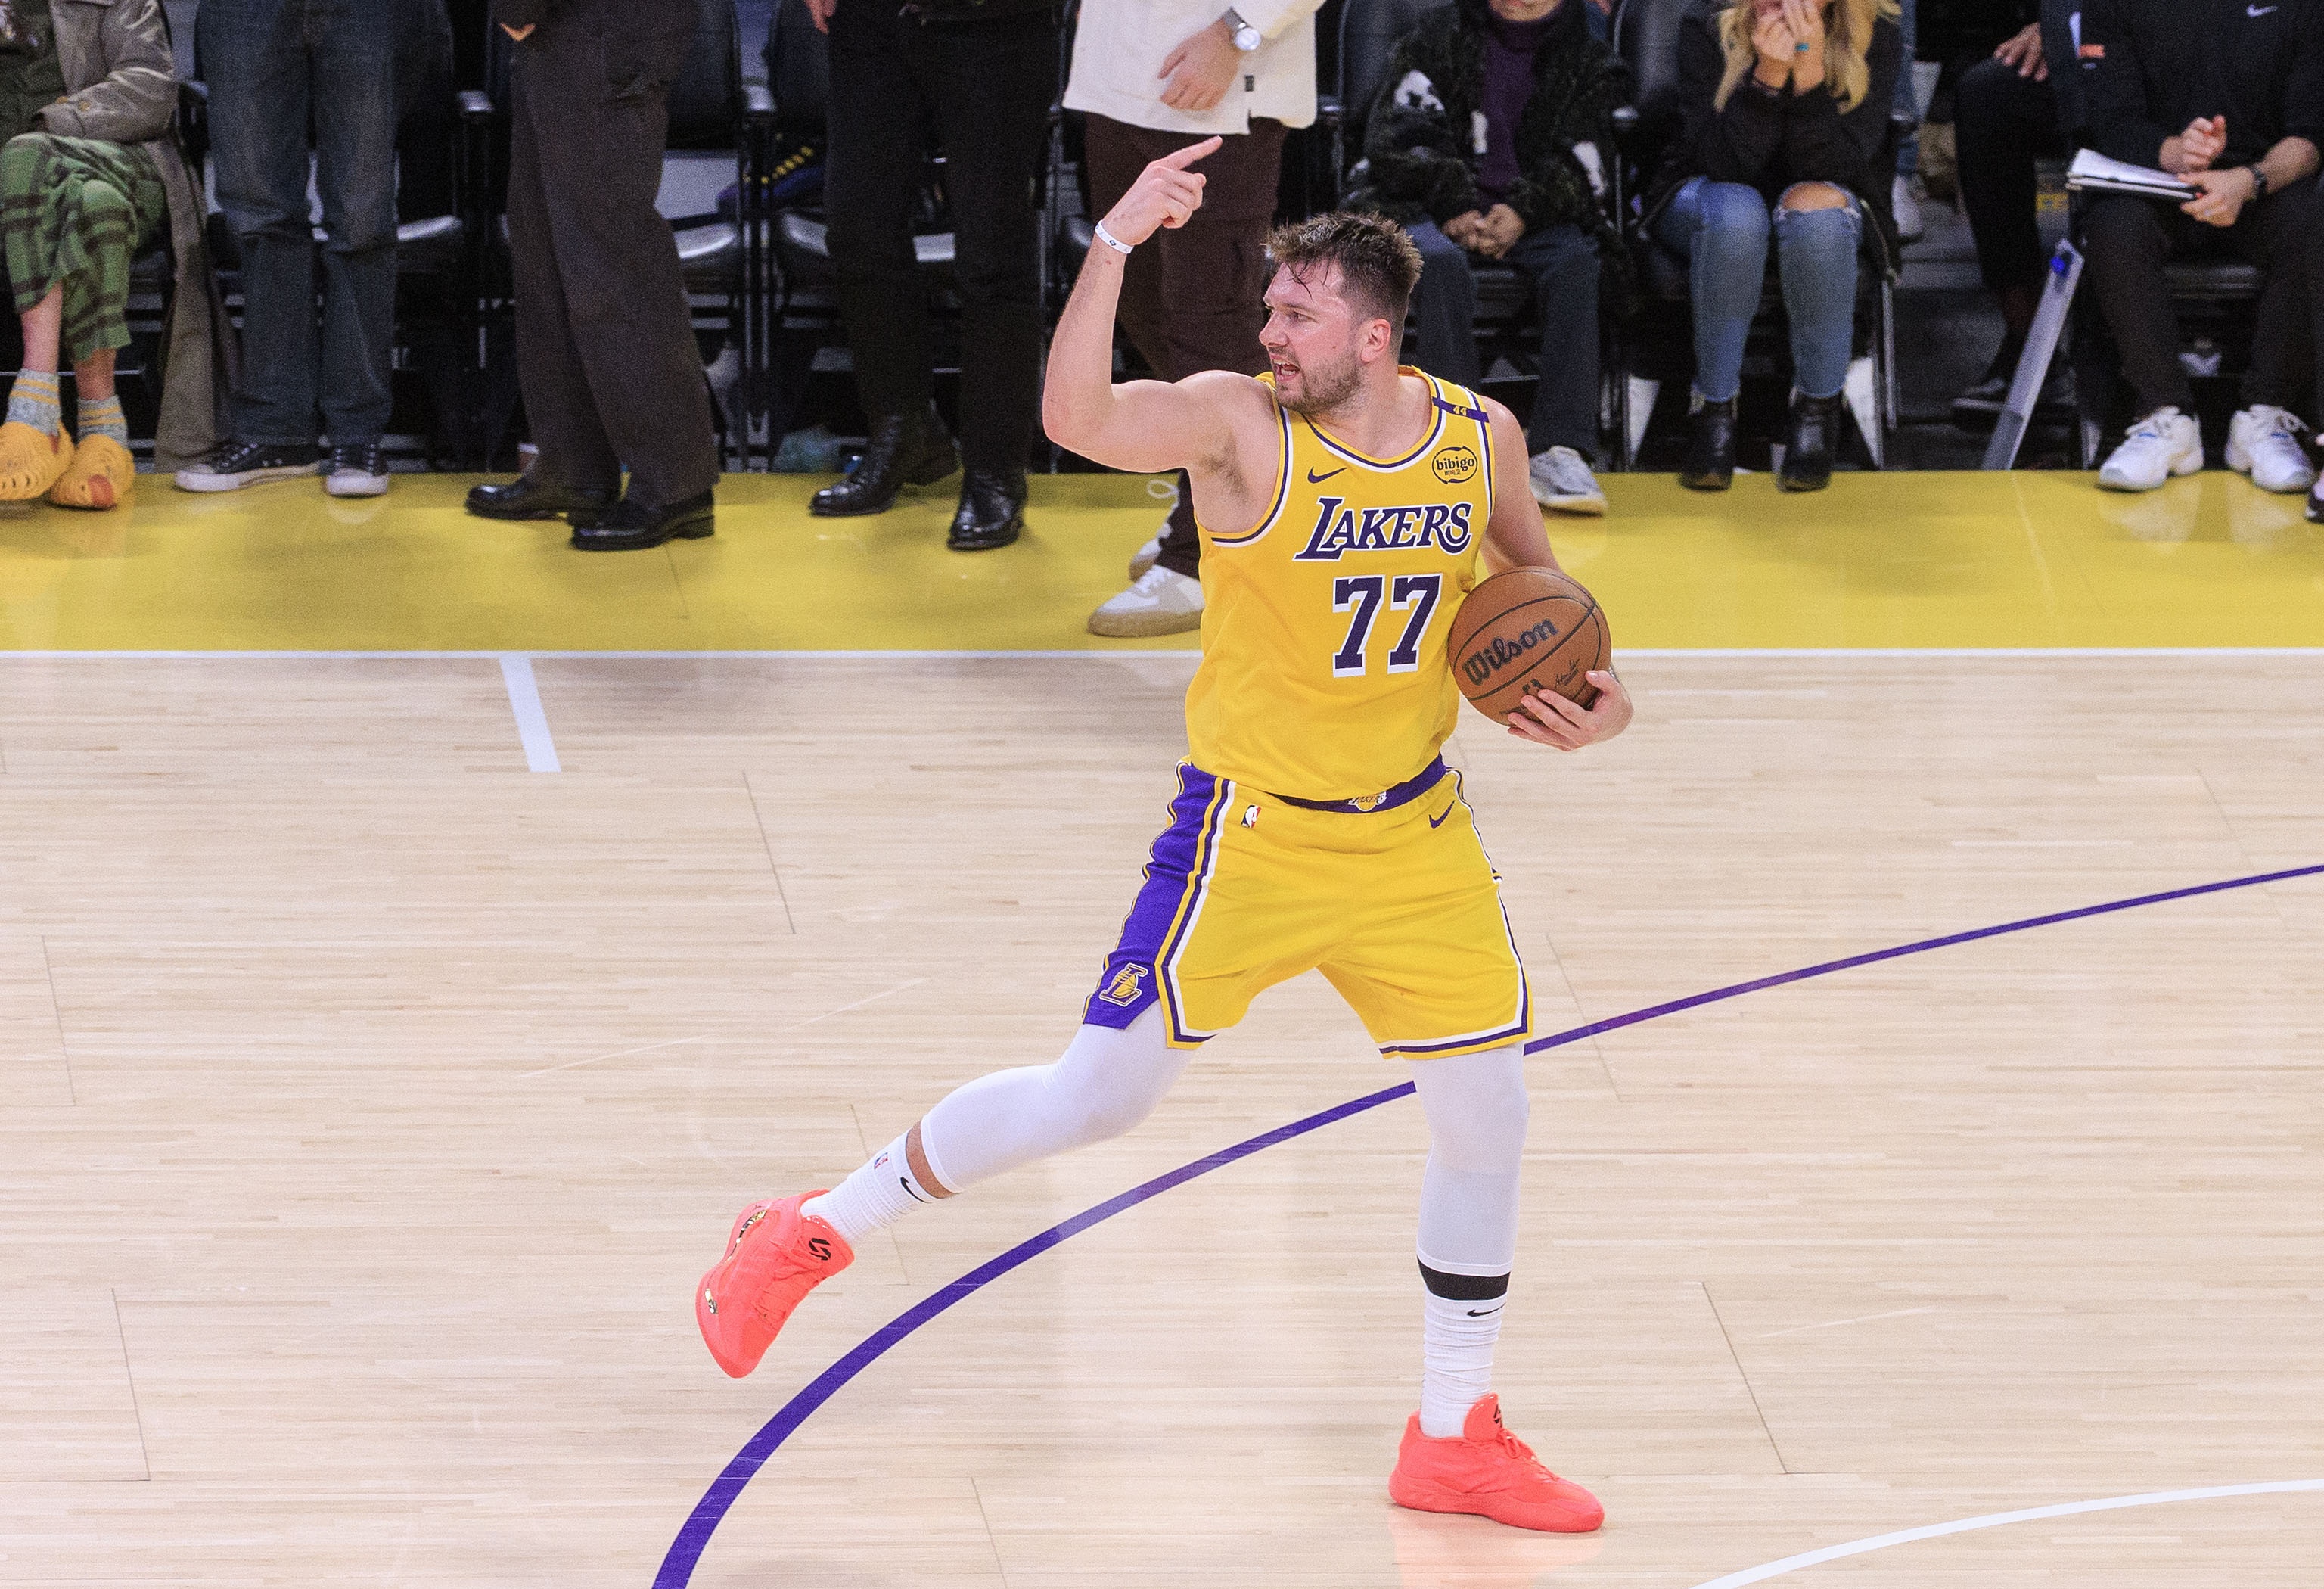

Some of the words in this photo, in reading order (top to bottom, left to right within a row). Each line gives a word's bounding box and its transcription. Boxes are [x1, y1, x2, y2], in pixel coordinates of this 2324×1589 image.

[1453, 406, 1467, 416] 44
[1436, 456, 1474, 471] bibigo
[1292, 496, 1474, 561] LAKERS
[1332, 573, 1443, 678] 77
[1462, 618, 1558, 686] Wilson
